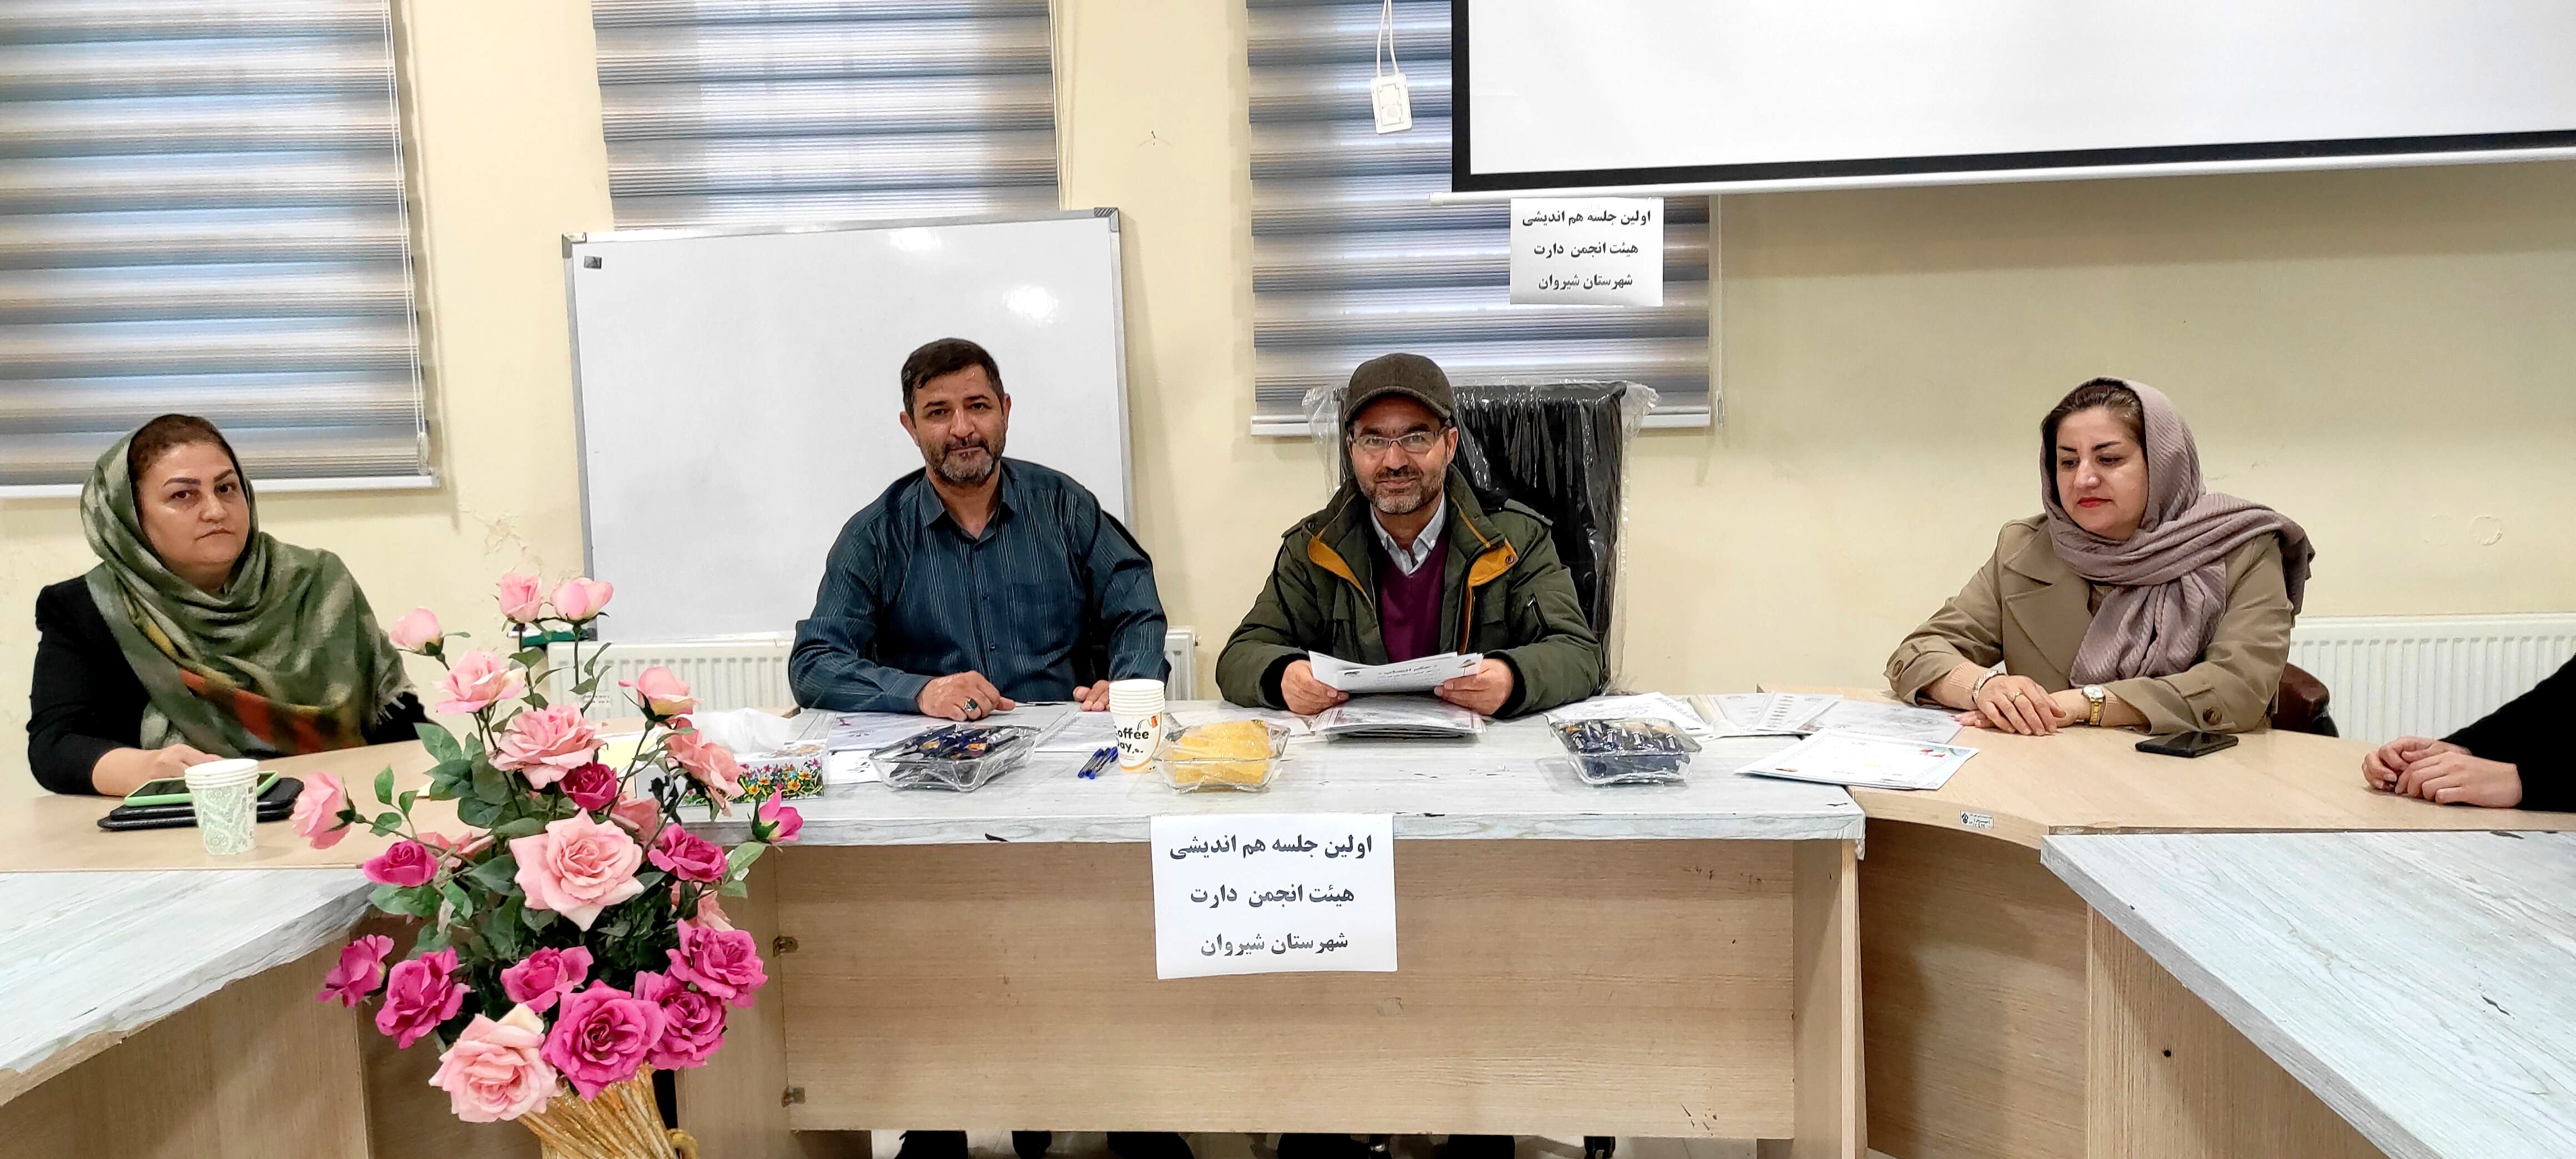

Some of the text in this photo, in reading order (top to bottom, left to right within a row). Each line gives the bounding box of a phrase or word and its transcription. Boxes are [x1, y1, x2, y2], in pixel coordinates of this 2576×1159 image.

[1522, 210, 1651, 226] اولین جلسه هم اندیشی
[1534, 241, 1638, 259] هیئت انجمن دارت
[1538, 274, 1633, 290] شهرستان شیروان
[1170, 834, 1372, 860] اولین جلسه هم اندیشی
[1190, 884, 1355, 909] هیئت انجمن دارت
[1201, 932, 1349, 956] شهرستان شیروان
